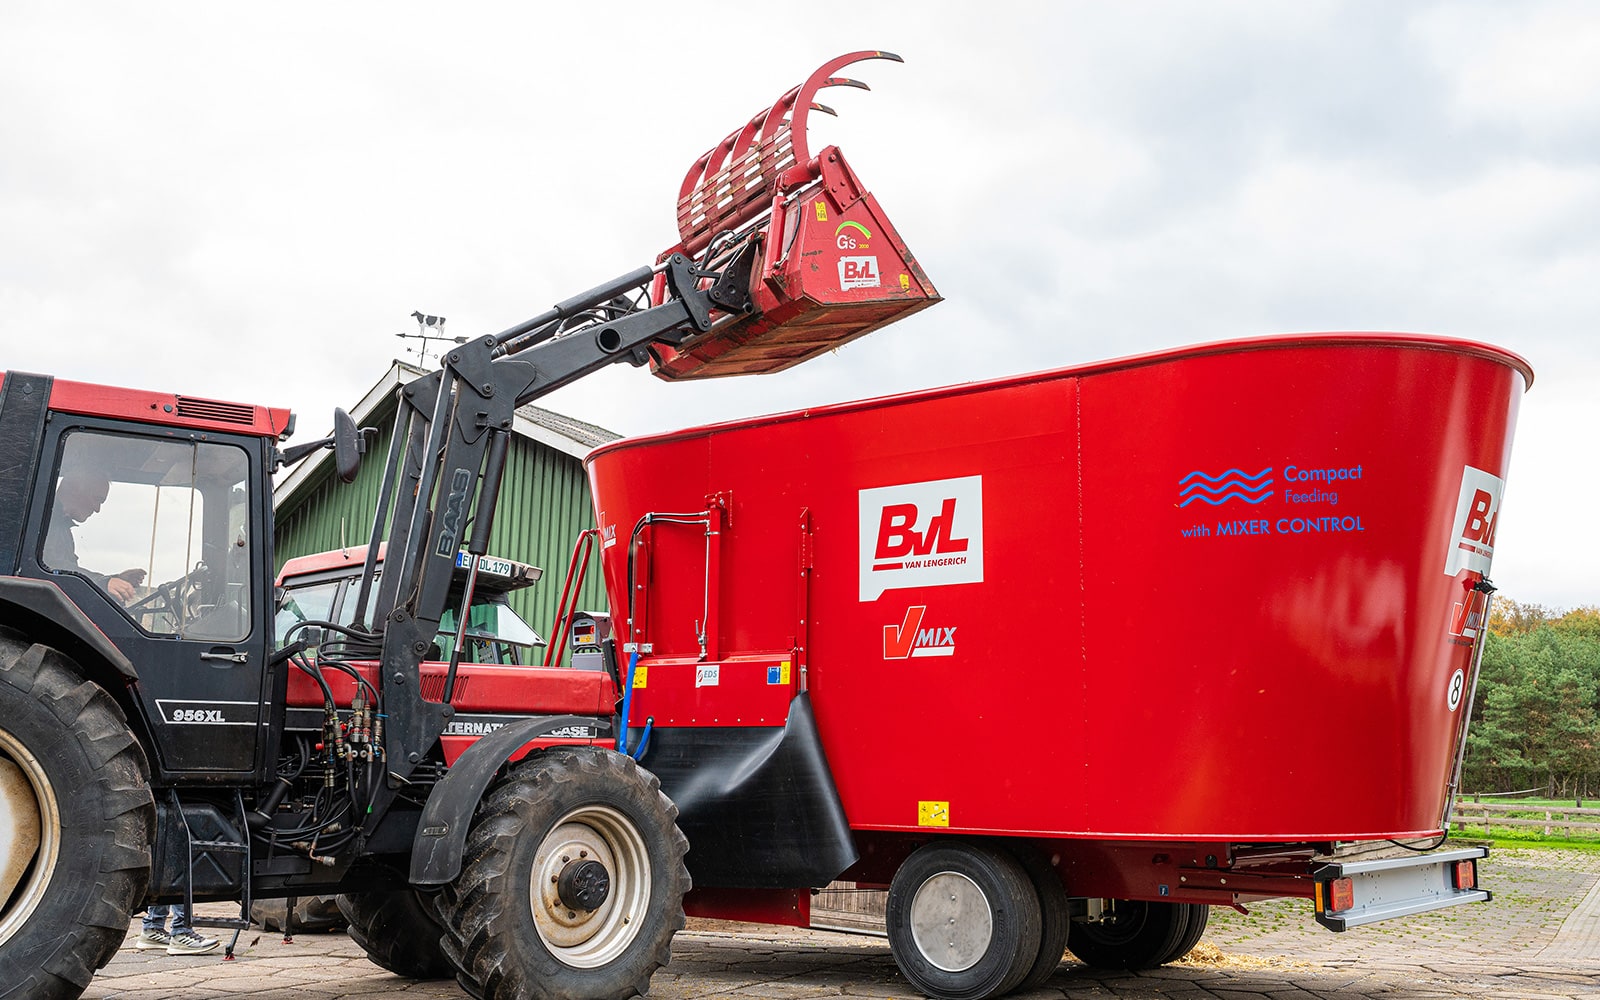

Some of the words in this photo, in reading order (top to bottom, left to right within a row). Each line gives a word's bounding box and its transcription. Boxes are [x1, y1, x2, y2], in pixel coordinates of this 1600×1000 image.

[1283, 465, 1363, 484] Compact
[1285, 488, 1338, 505] Feeding
[1181, 524, 1211, 537] with
[1216, 519, 1270, 536] MIXER
[1276, 516, 1365, 534] CONTROL
[480, 559, 491, 571] DL
[492, 561, 510, 575] 179
[905, 561, 922, 569] VAN
[923, 556, 967, 568] LENGERICH
[704, 670, 717, 678] EDS
[1451, 674, 1461, 705] 8
[173, 709, 226, 722] 956XL
